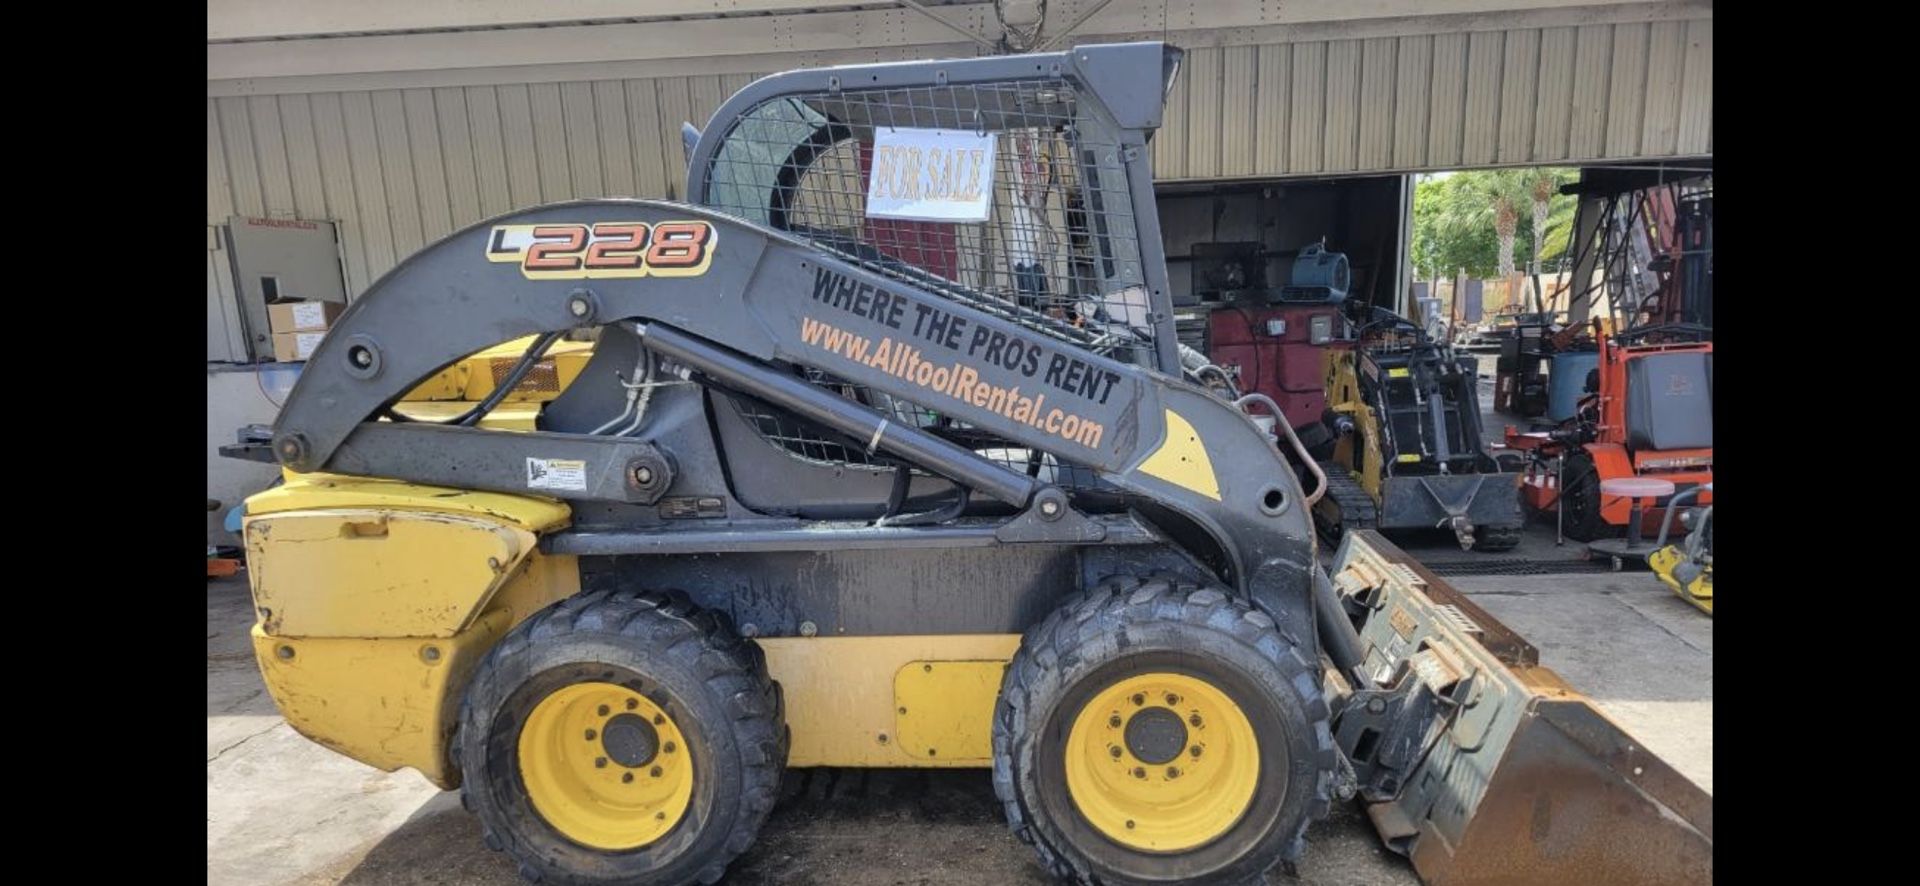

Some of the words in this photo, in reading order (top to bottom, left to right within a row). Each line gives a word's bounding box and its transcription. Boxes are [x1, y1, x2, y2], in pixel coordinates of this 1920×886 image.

[876, 145, 922, 200] FOR
[925, 147, 984, 202] SALE
[800, 316, 1104, 450] www.AlltoolRental.com
[811, 266, 907, 330] WHERE
[912, 302, 967, 351] THE
[968, 325, 1042, 378] PROS
[1044, 352, 1122, 405] RENT
